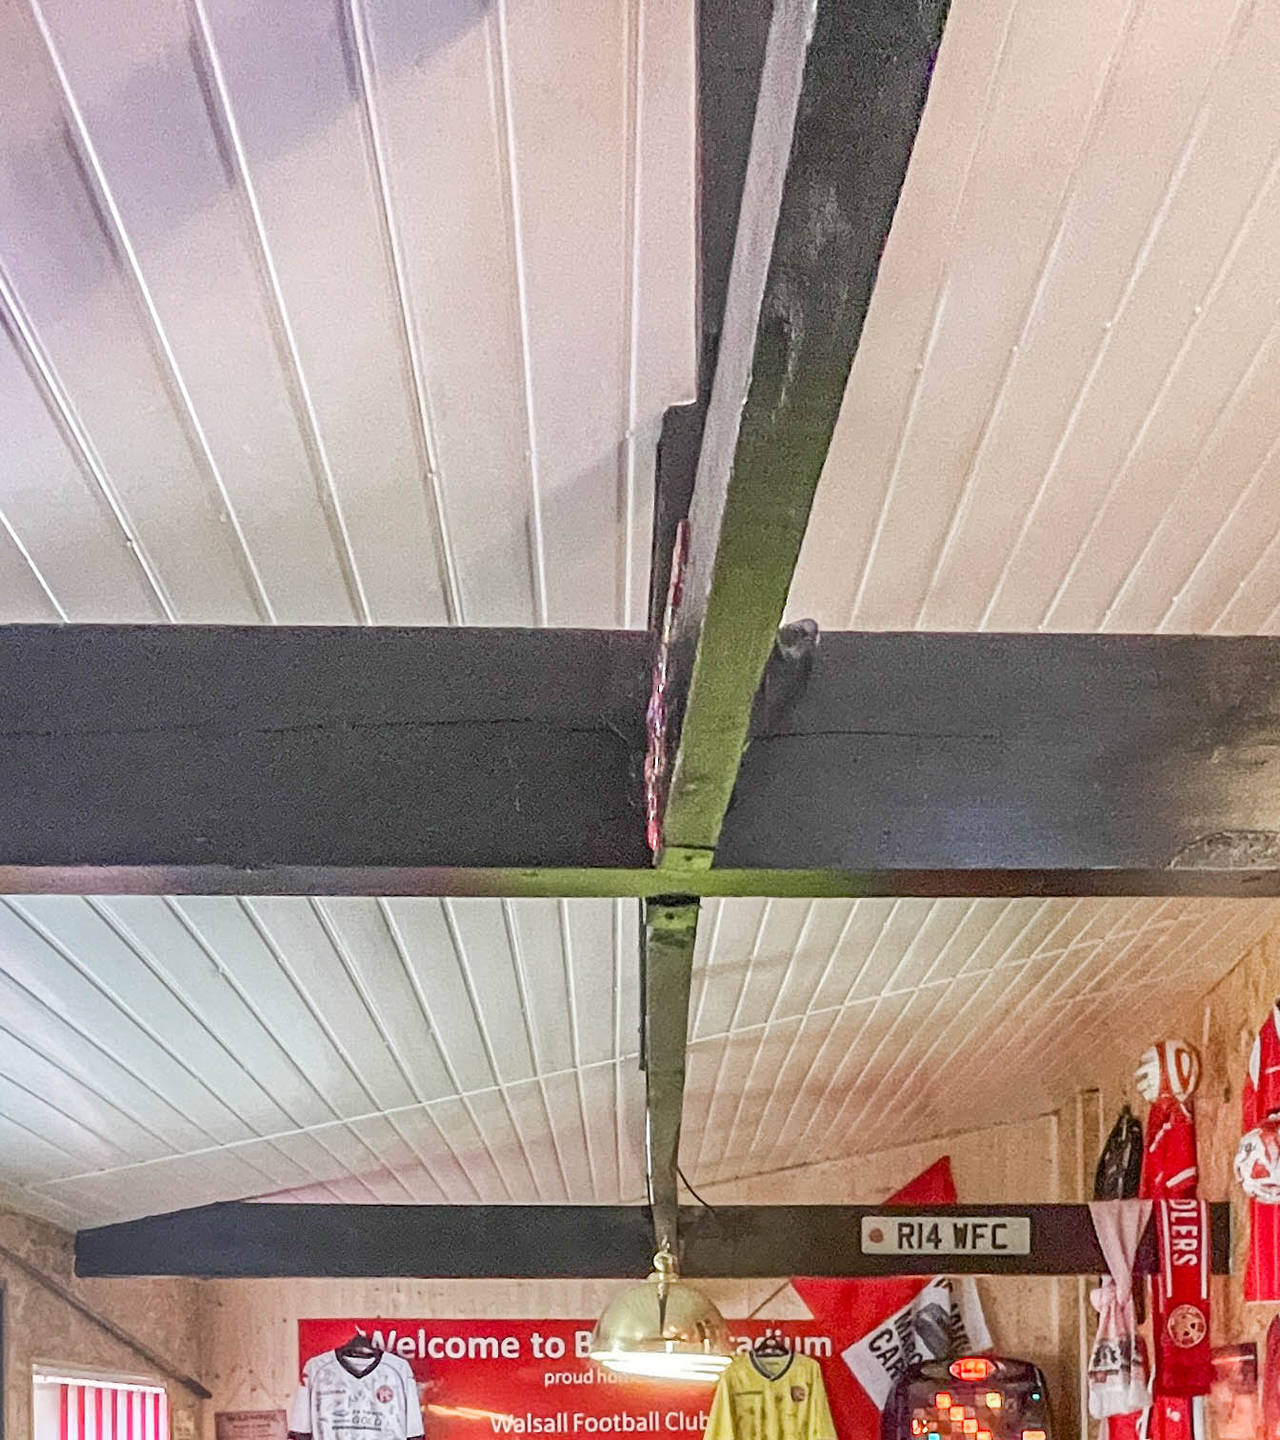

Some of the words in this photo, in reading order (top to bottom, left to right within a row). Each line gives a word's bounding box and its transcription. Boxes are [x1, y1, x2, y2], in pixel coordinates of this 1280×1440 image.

[897, 1222, 942, 1249] R14
[953, 1222, 1008, 1250] WFC
[369, 1328, 520, 1360] Welcome
[530, 1331, 565, 1359] to
[544, 1368, 594, 1387] proud
[490, 1412, 568, 1433] Walsall
[573, 1411, 660, 1432] Football
[665, 1410, 709, 1432] Club
